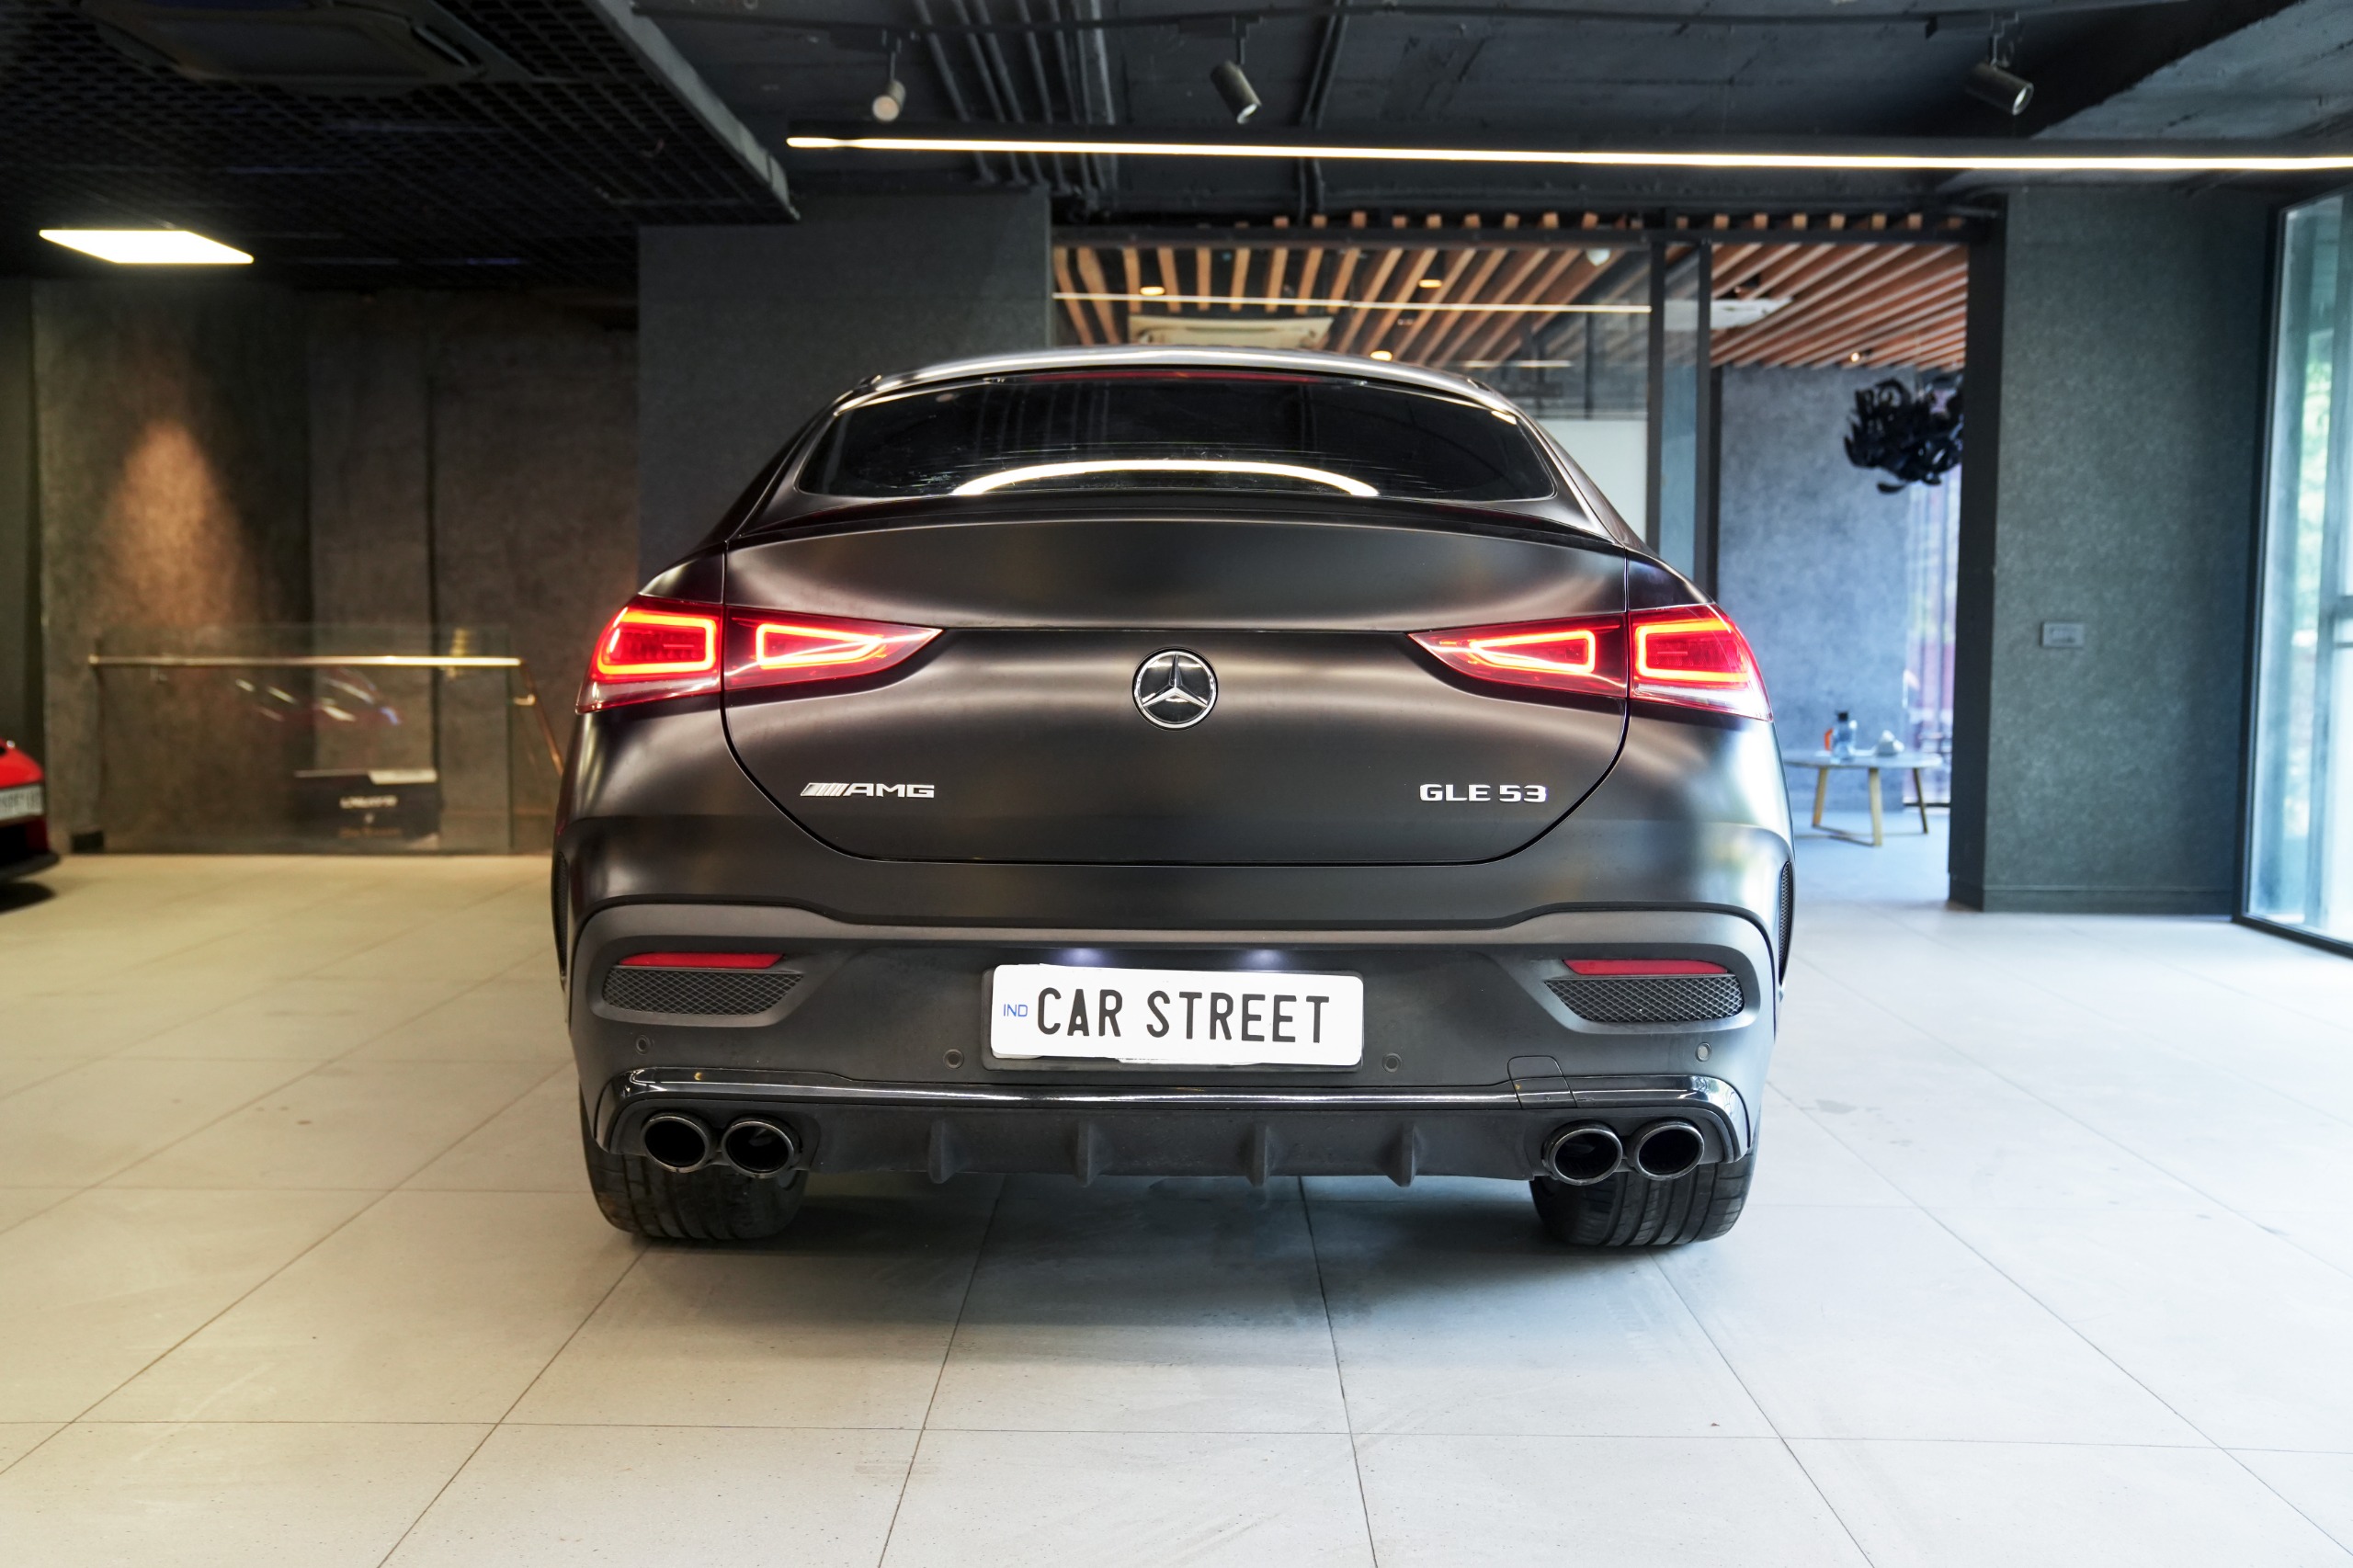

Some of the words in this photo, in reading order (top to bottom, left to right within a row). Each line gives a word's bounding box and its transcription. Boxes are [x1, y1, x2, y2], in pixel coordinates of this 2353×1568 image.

[842, 782, 935, 799] AMG
[1419, 783, 1492, 801] GLE
[1498, 784, 1547, 803] 53
[1003, 1003, 1029, 1017] IND
[1037, 987, 1123, 1038] CAR
[1146, 990, 1330, 1044] STREET
